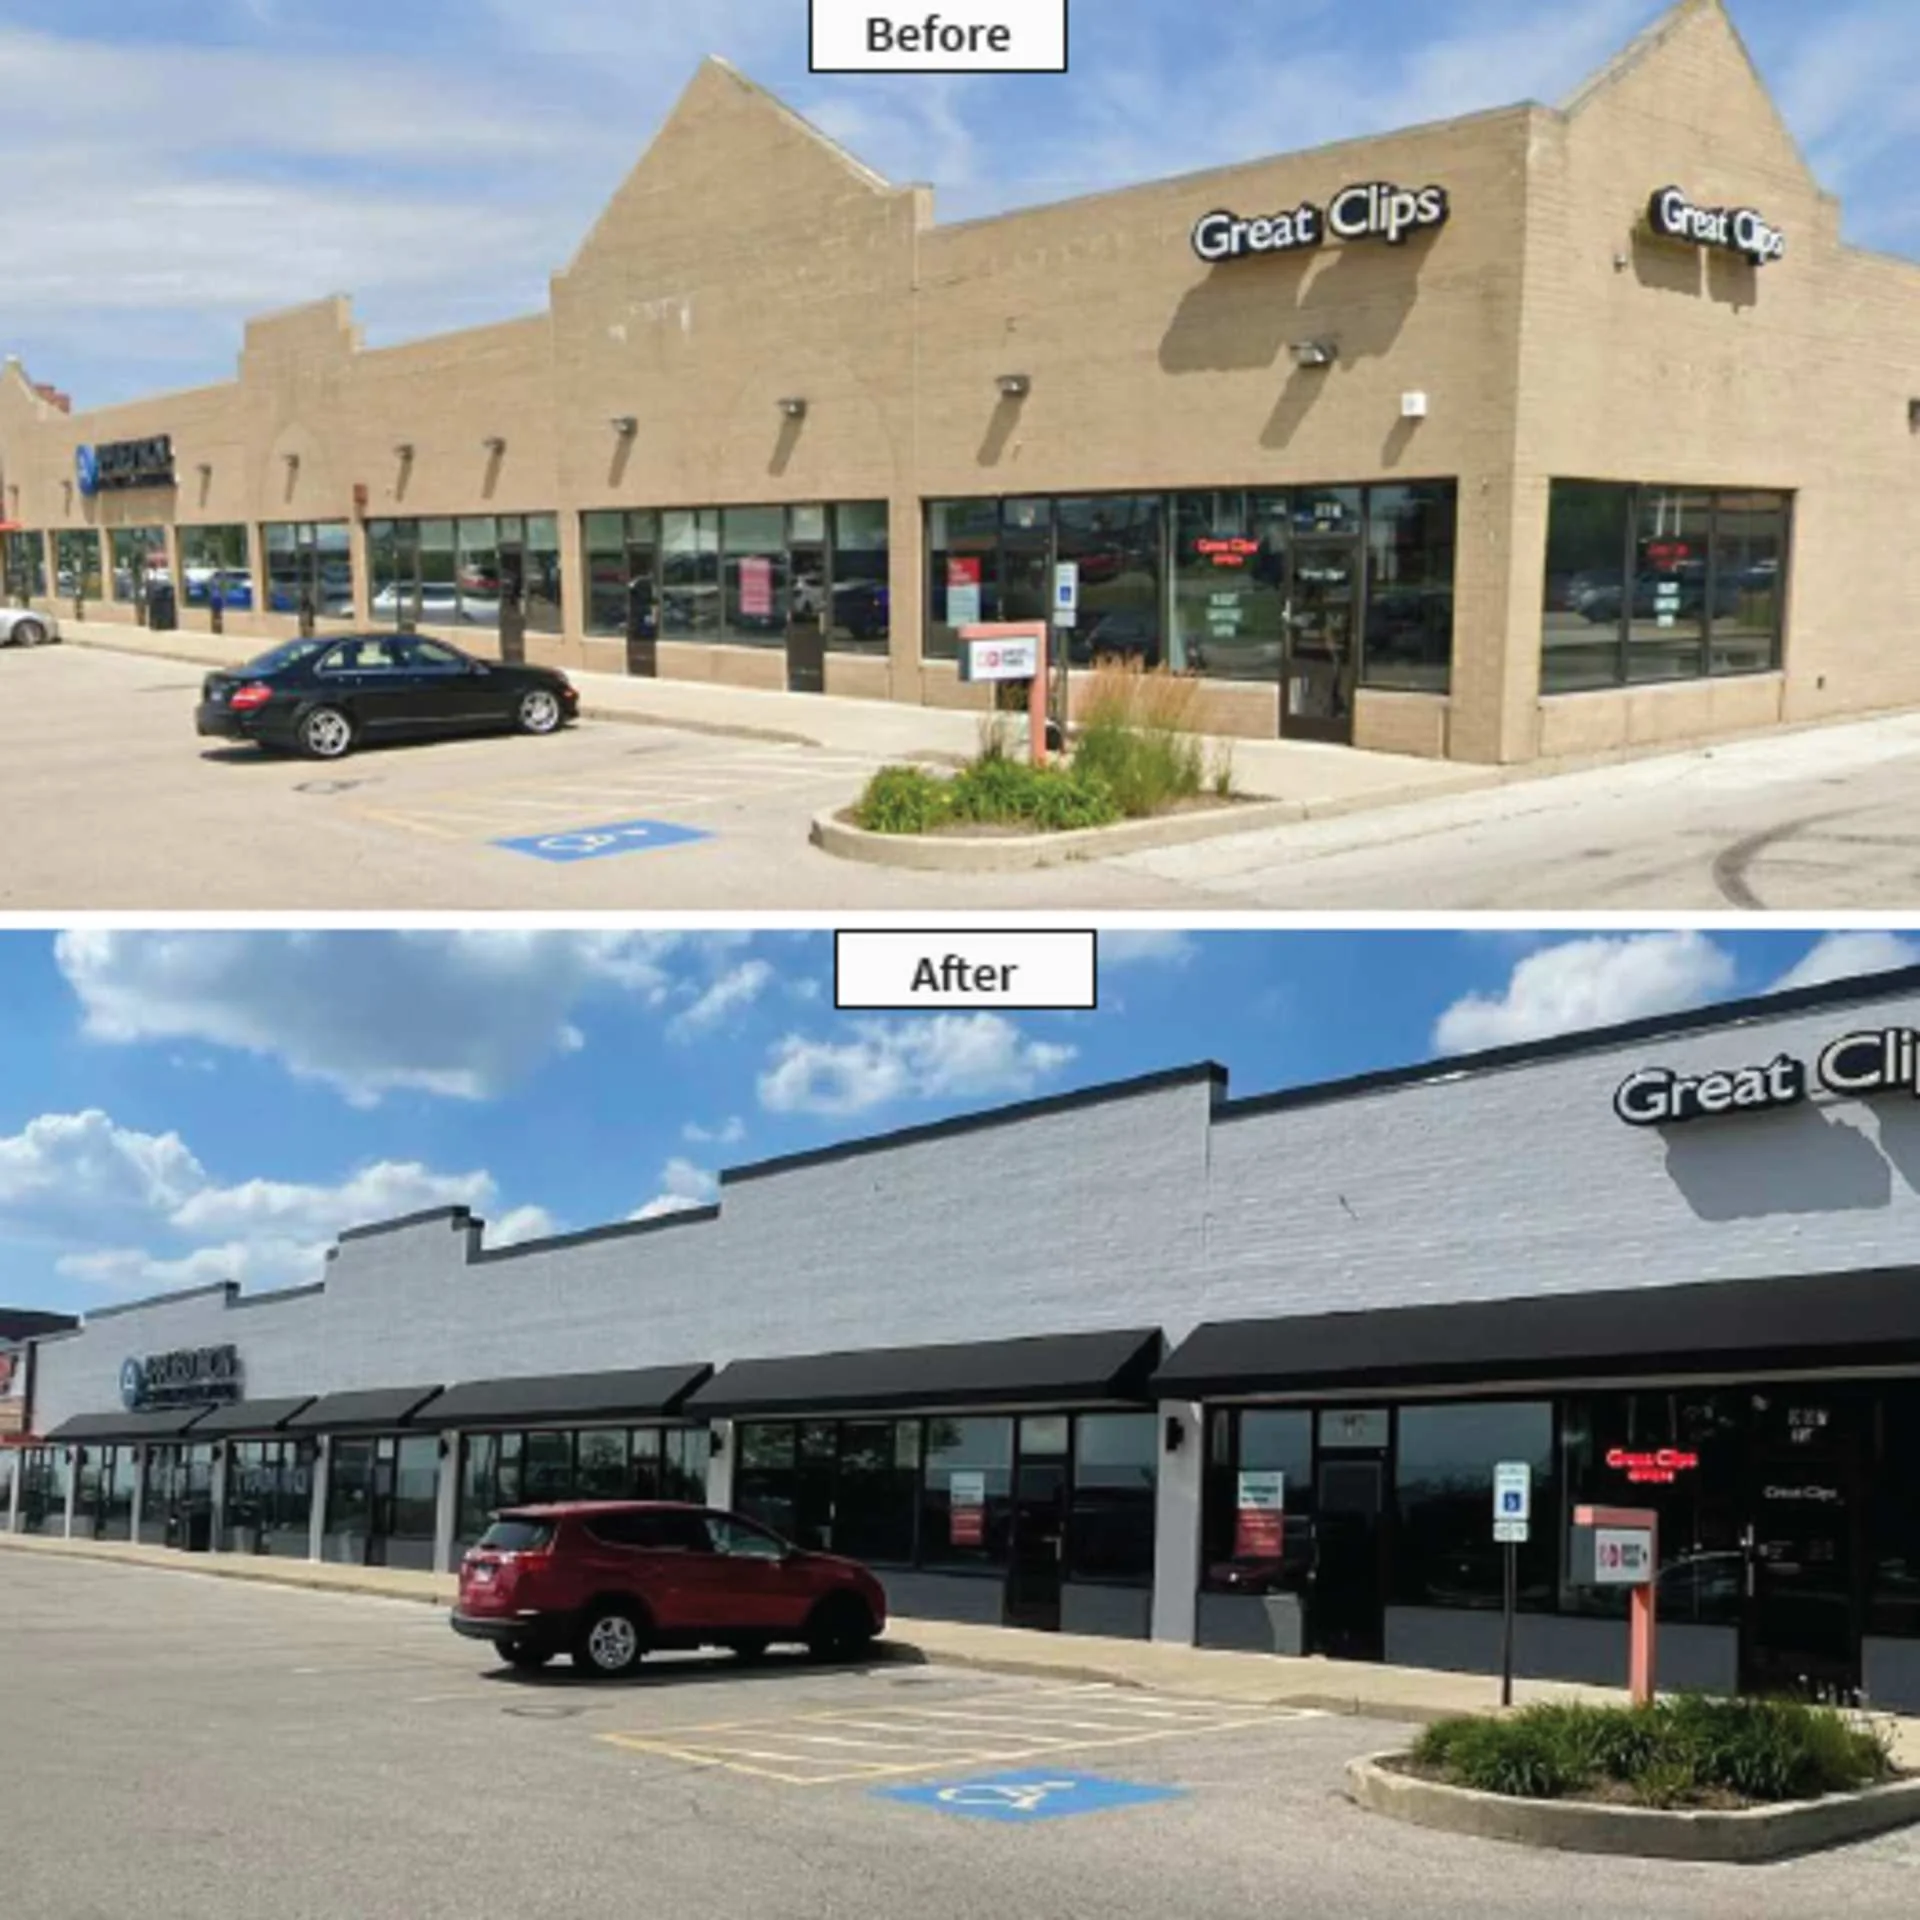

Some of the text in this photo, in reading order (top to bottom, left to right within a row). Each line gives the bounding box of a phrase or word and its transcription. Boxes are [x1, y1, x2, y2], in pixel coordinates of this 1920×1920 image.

[1194, 184, 1441, 259] Great Clips
[1660, 189, 1729, 244] Great
[1617, 1029, 1920, 1121] Great Cli
